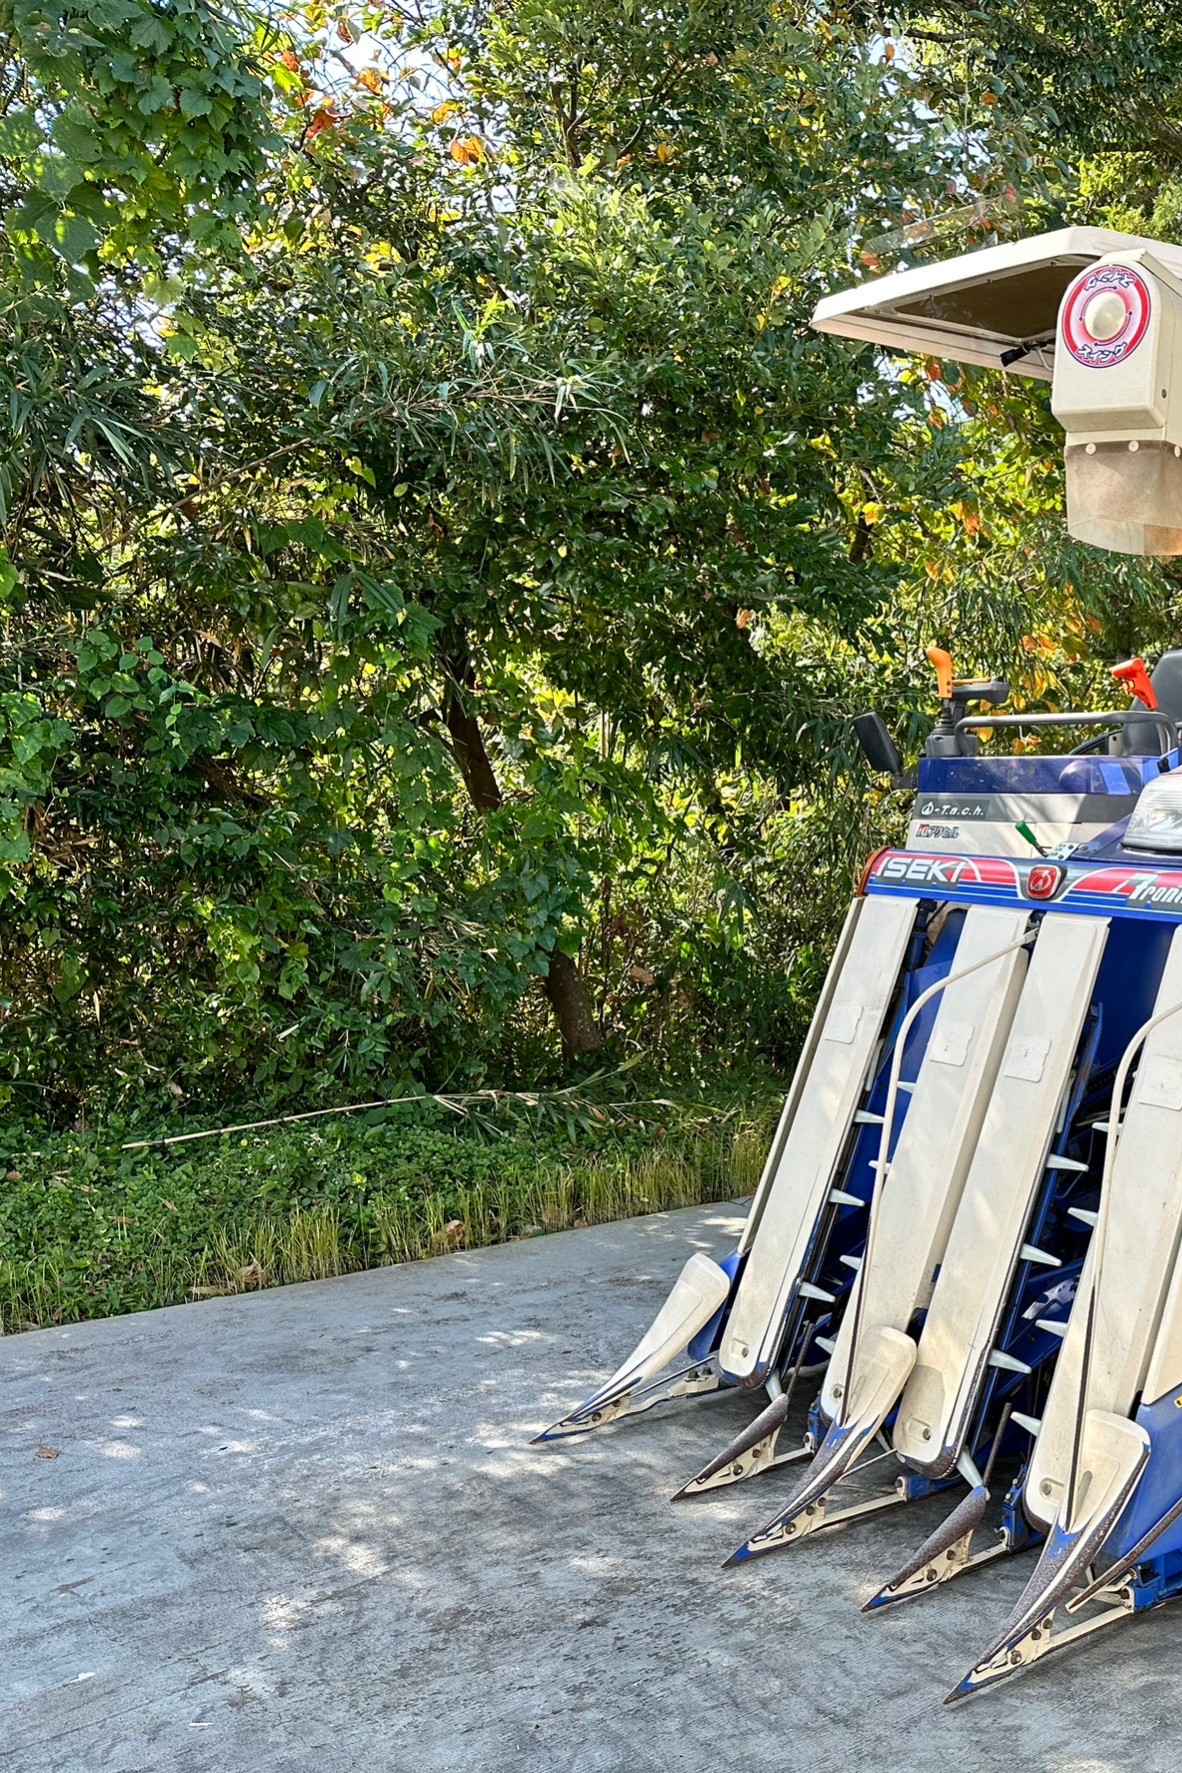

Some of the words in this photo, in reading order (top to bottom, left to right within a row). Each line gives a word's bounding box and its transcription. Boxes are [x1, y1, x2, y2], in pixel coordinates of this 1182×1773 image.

[1078, 342, 1127, 363] スイング
[876, 856, 967, 884] ISEKI
